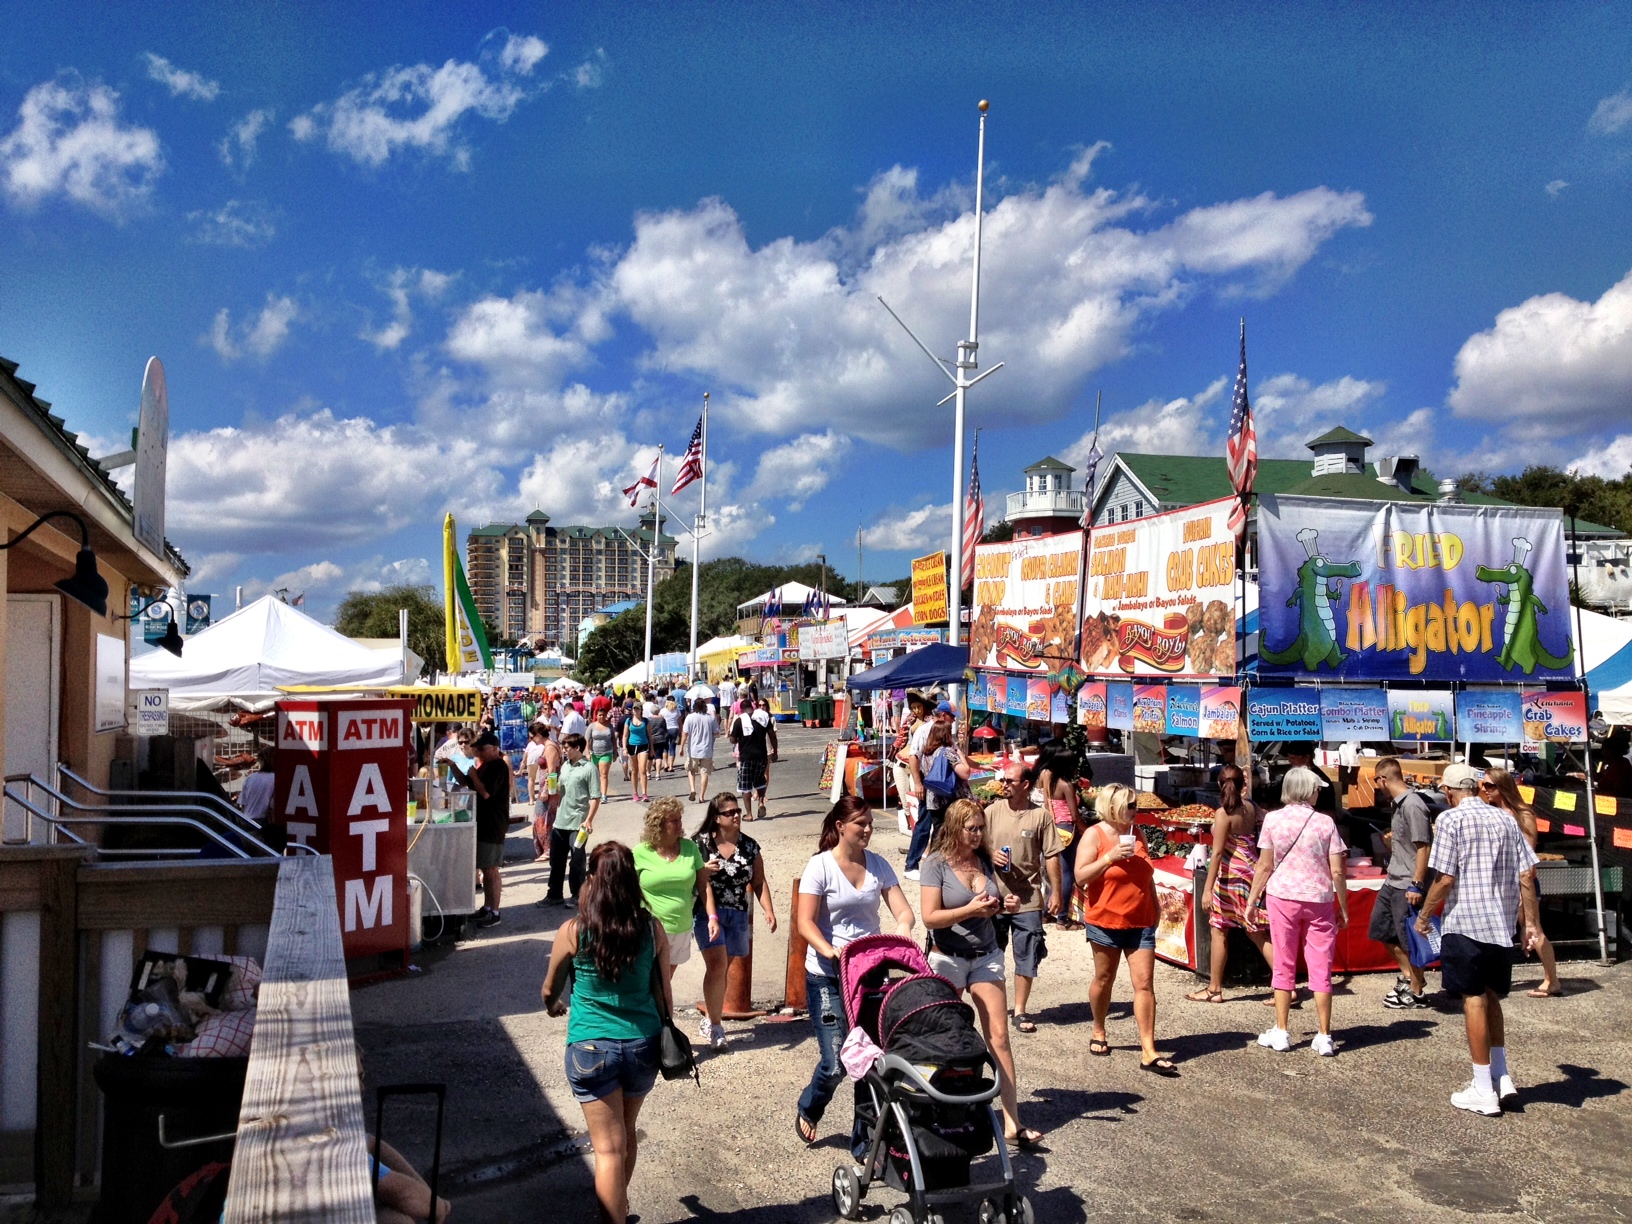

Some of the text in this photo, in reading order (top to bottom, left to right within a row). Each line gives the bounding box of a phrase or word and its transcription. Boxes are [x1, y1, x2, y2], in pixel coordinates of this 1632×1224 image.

[1372, 523, 1463, 571] FRIED
[976, 552, 1011, 579] COCONUT
[1090, 547, 1126, 577] SALMON
[1166, 541, 1234, 593] CRAB CAKES
[1101, 571, 1148, 600] MAHI-MAHI
[1118, 598, 1148, 612] Jambalaya
[1149, 600, 1155, 608] or
[1155, 597, 1177, 609] Bayou
[1177, 594, 1197, 605] Salads
[915, 610, 928, 622] CORN
[929, 606, 946, 621] DOGS
[1024, 607, 1039, 617] Bayou
[1346, 580, 1494, 675] Alligator
[145, 696, 162, 706] NO
[1203, 705, 1237, 721] Jambalaya
[1250, 703, 1319, 716] Cajun Platter
[1321, 706, 1387, 716] Combo Platter
[1467, 709, 1512, 721] Pineapple
[1525, 708, 1553, 721] Crab
[1171, 713, 1198, 729] Salmon
[1286, 719, 1318, 727] Potatoes,
[1403, 716, 1437, 739] Alligator
[1474, 723, 1507, 735] Shrimp
[283, 720, 324, 742] ATM
[343, 718, 399, 741] ATM
[1270, 728, 1275, 736] &
[1544, 723, 1582, 737] Cakes
[346, 763, 393, 932] ATM
